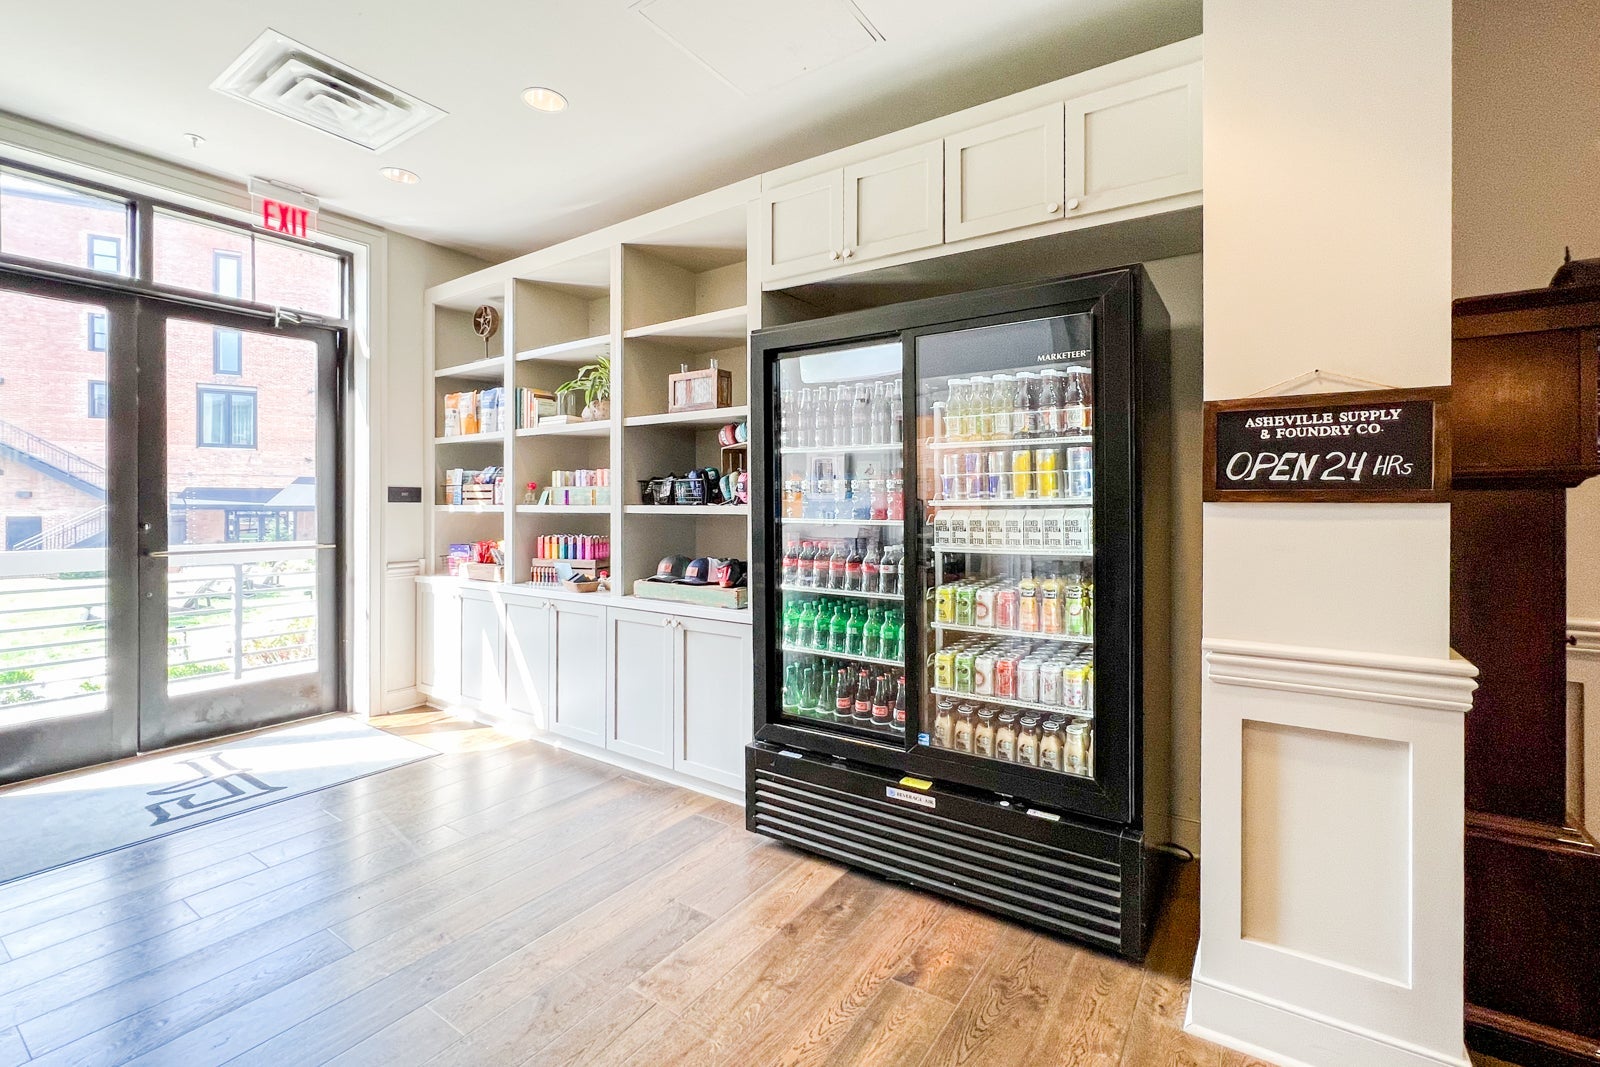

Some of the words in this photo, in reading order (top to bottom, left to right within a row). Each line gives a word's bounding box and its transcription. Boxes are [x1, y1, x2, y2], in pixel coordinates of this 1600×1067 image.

[263, 197, 309, 239] EXIT
[1037, 350, 1087, 362] MARKETEER
[1245, 412, 1333, 428] ASHEVILLE
[1339, 408, 1402, 423] SUPPLY
[1260, 429, 1270, 440] &
[1275, 424, 1353, 439] FOUNDRY
[1356, 423, 1384, 434] CO.
[1226, 451, 1320, 481] OPEN
[1320, 451, 1368, 481] 24
